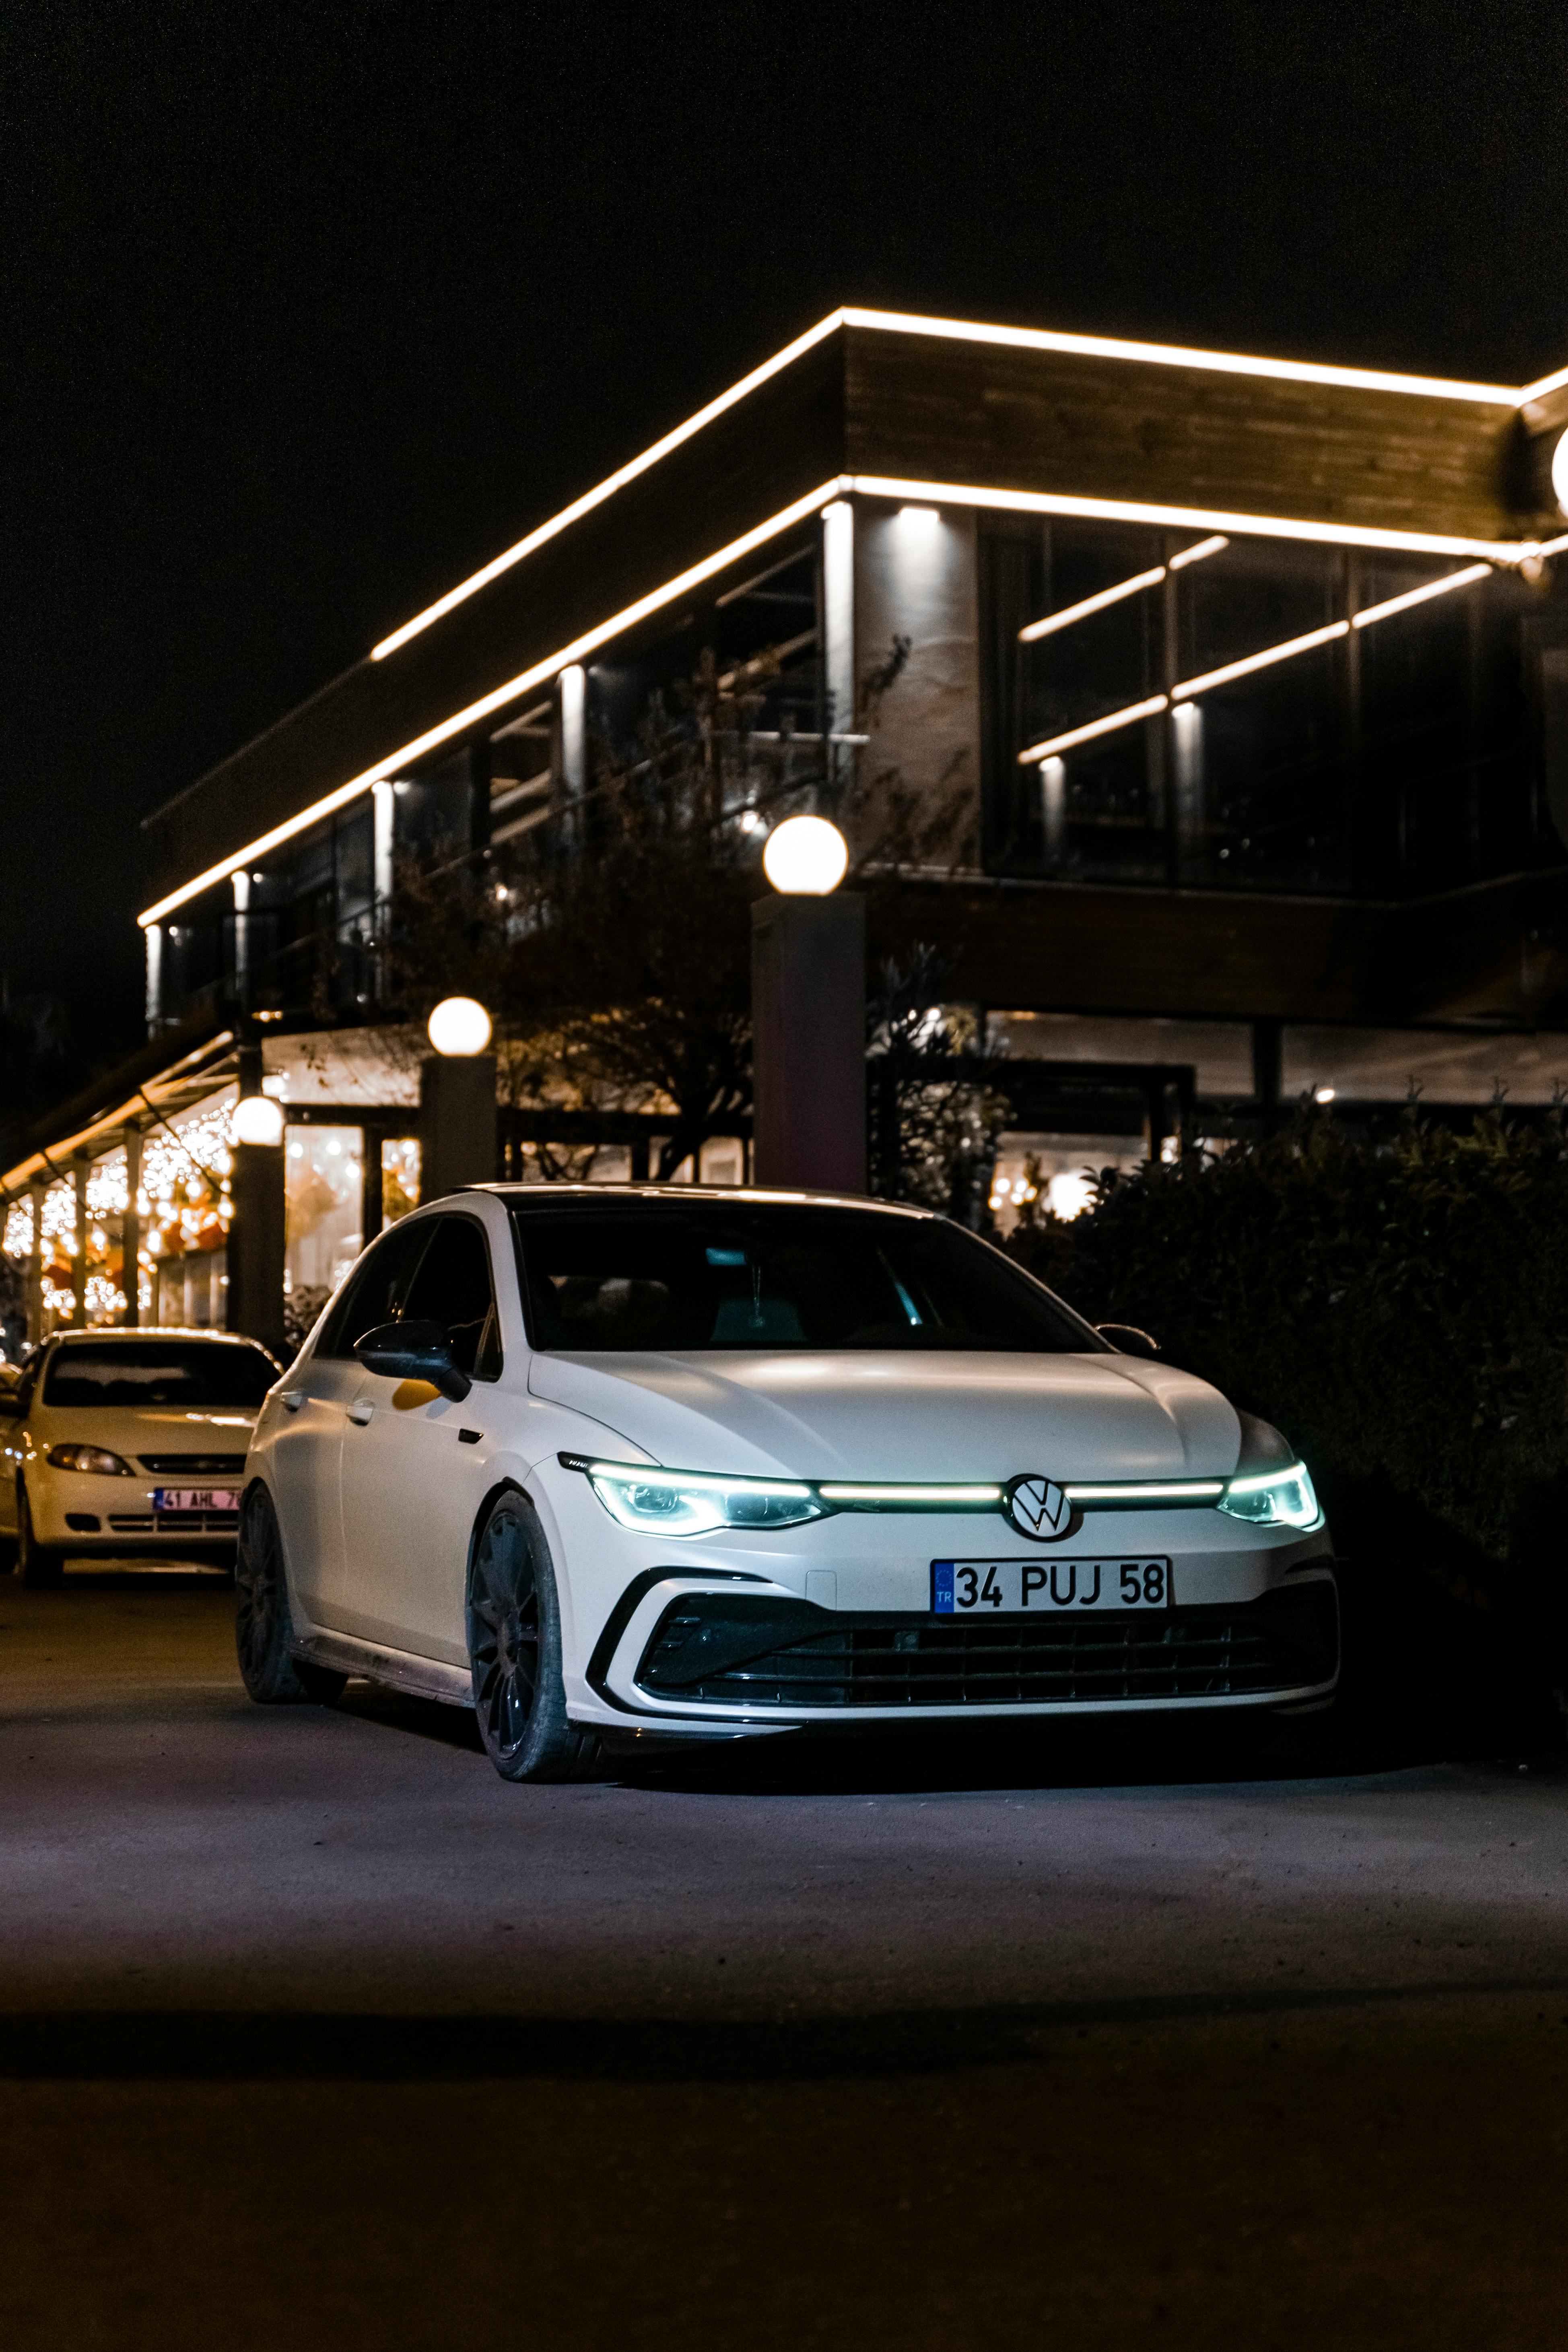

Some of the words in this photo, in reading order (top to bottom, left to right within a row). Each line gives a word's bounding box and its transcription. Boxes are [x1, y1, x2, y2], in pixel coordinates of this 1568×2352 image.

[165, 1491, 181, 1507] 41
[190, 1491, 218, 1508] AHL
[956, 1567, 1003, 1608] 34
[1021, 1565, 1101, 1606] PUJ
[1120, 1563, 1164, 1604] 58
[936, 1591, 952, 1603] TR
